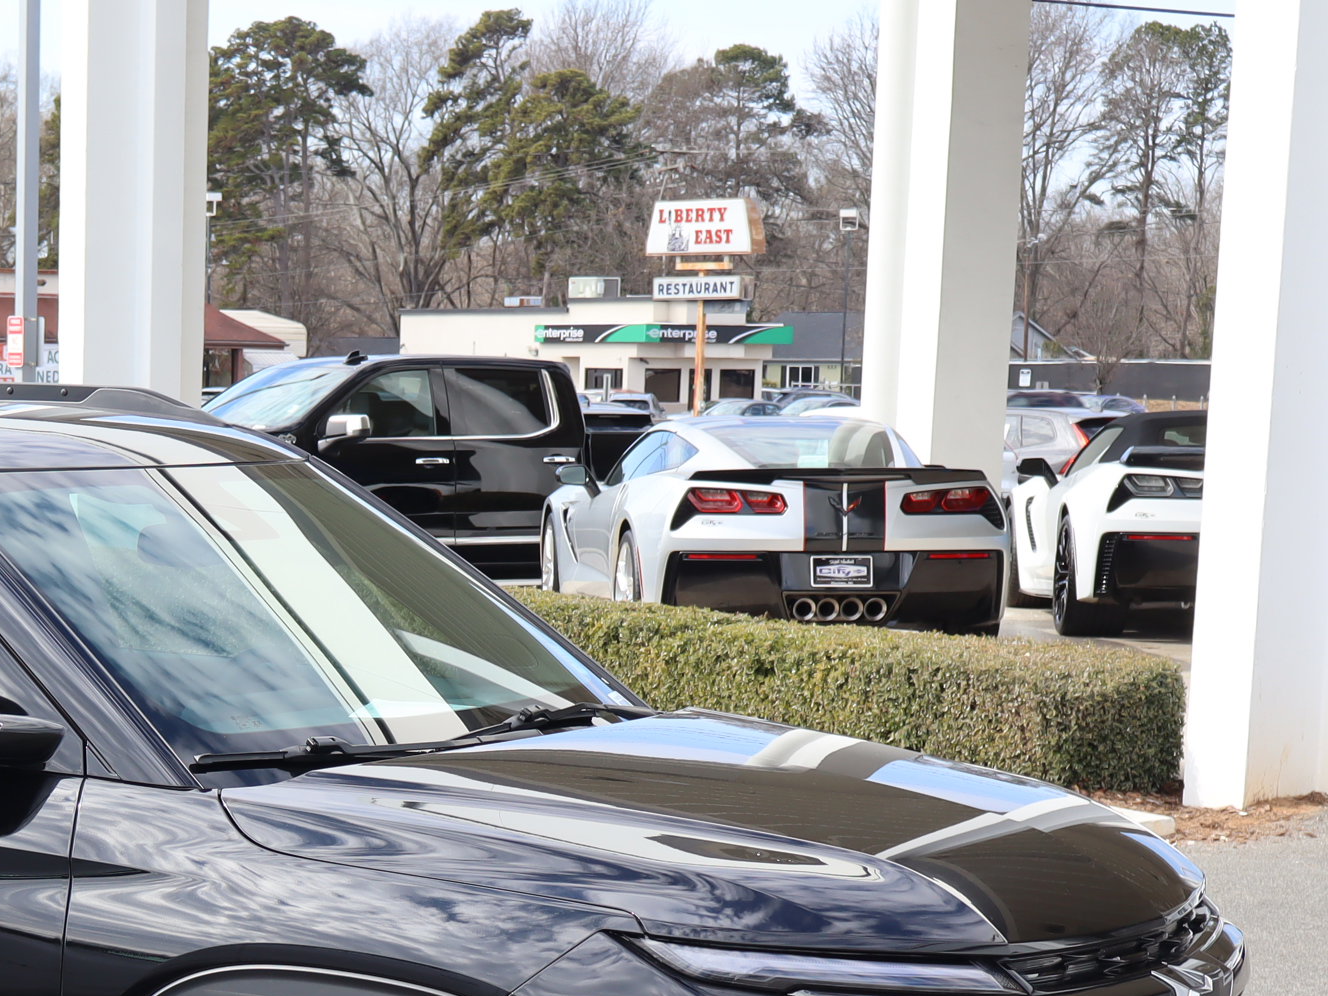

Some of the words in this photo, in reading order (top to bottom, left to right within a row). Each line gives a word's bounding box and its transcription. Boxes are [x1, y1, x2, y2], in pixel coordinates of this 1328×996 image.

[658, 207, 727, 224] LIBERTY
[694, 229, 733, 245] EAST
[658, 281, 735, 296] RESTAURANT
[535, 327, 584, 340] enterprise
[647, 328, 718, 341] enterpse
